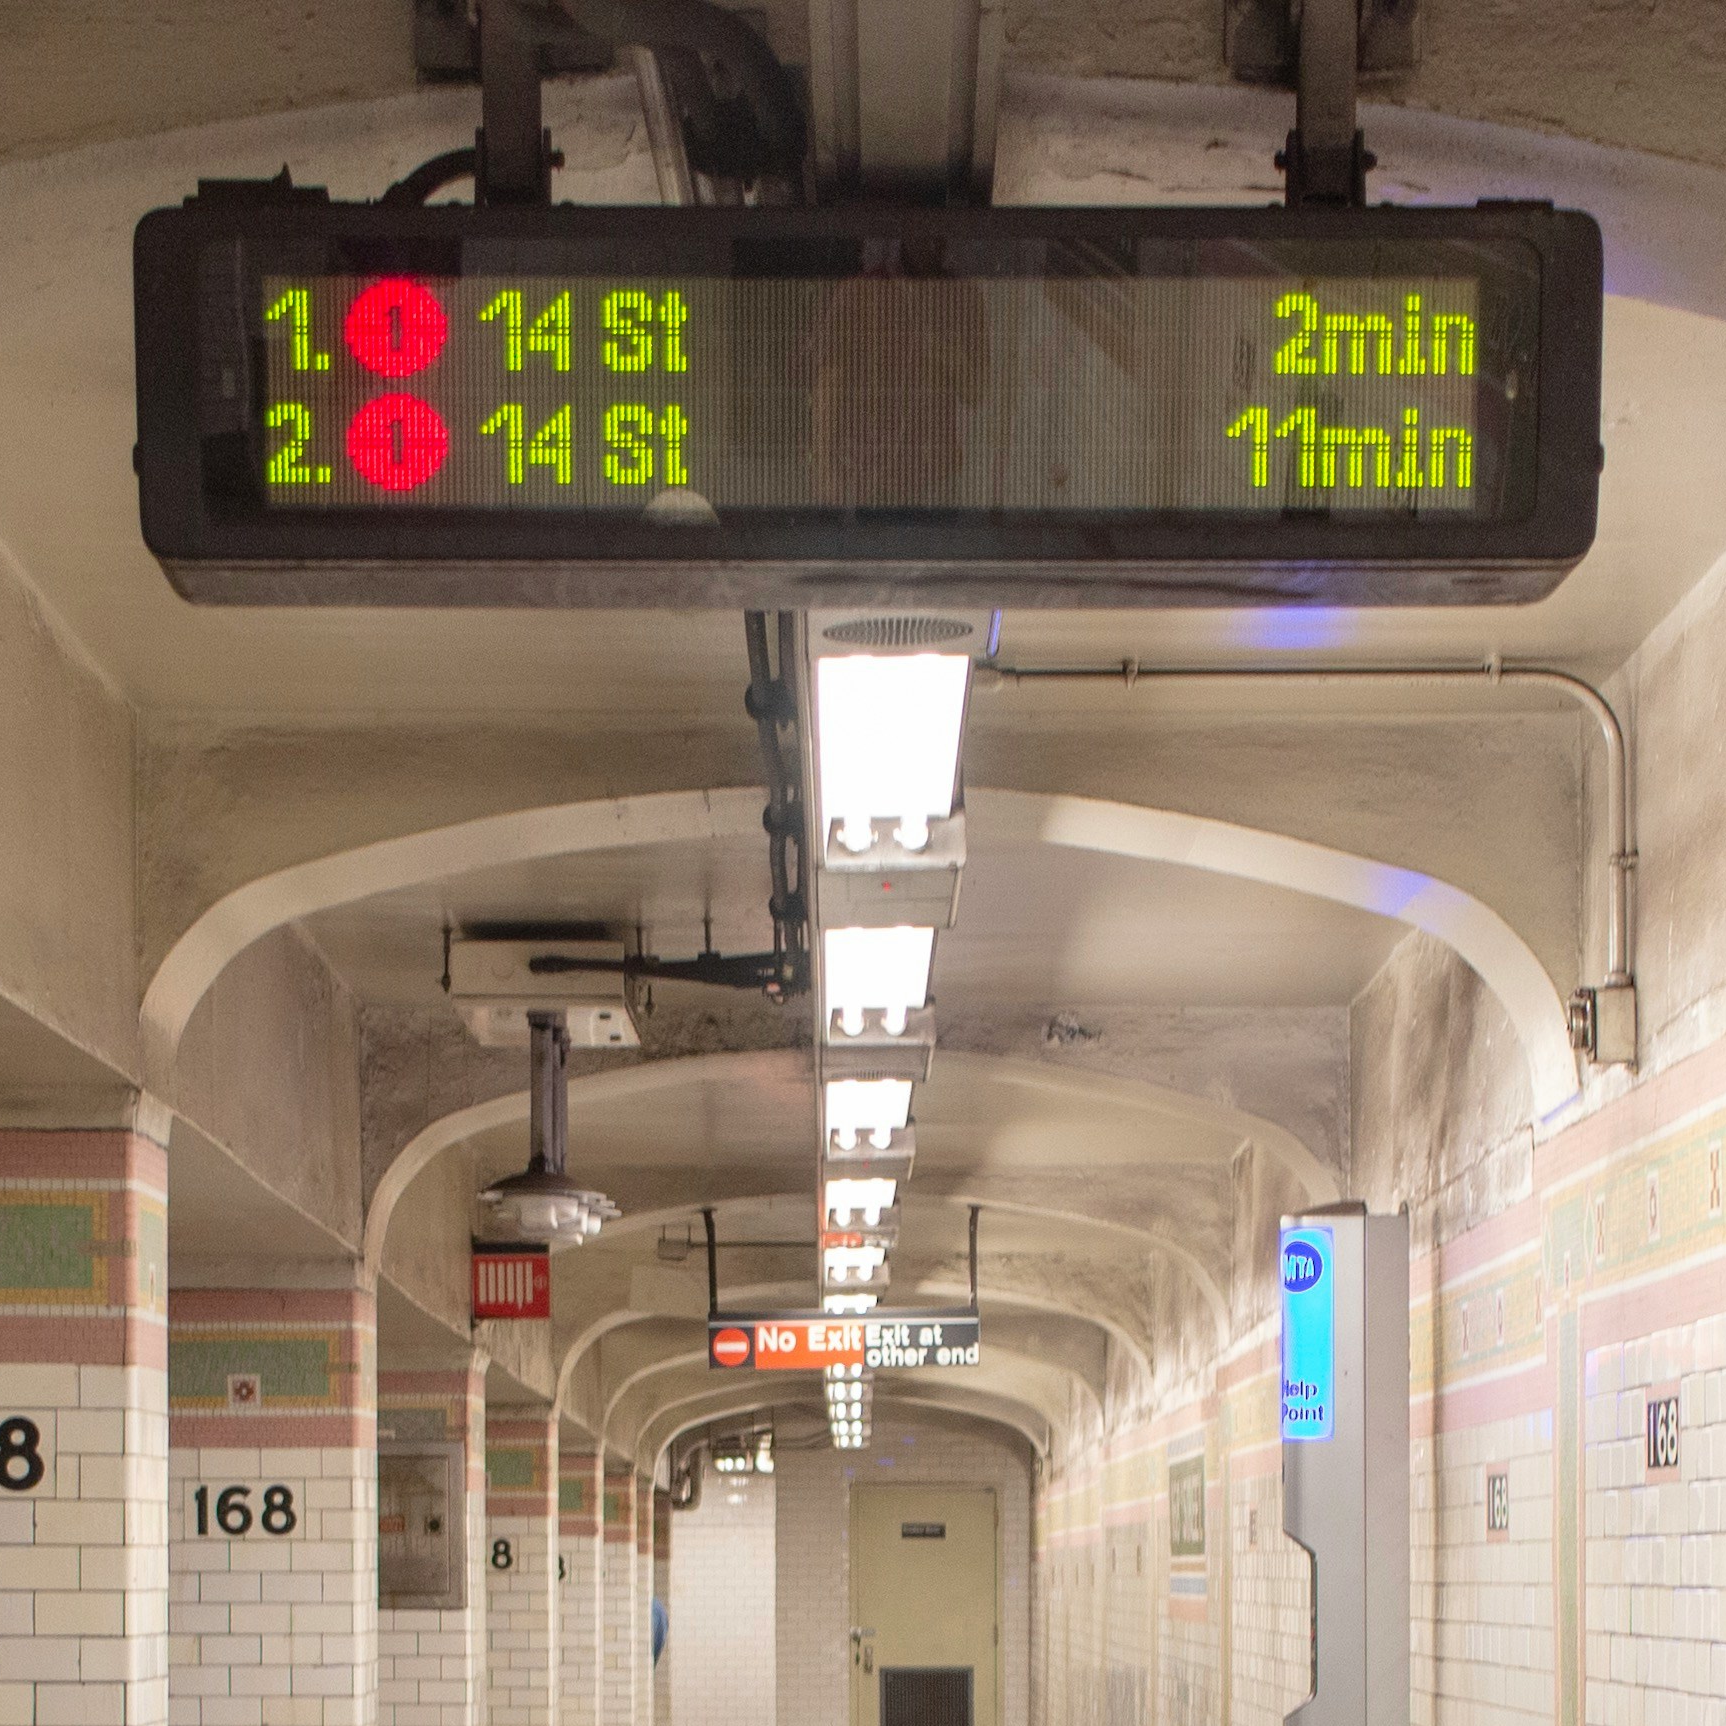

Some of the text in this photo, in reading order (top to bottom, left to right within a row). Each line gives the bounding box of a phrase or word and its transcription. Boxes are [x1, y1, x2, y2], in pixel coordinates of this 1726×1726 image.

[264, 288, 330, 371] 1.
[479, 289, 571, 372] 14
[602, 289, 689, 373] St
[1274, 292, 1474, 375] 2min
[264, 402, 332, 484] 2.
[479, 403, 572, 485] 14
[602, 403, 689, 486] St
[1224, 406, 1473, 488] 11min
[1282, 1253, 1316, 1281] MTA
[757, 1324, 863, 1353] No Exit
[865, 1323, 943, 1348] Exit at
[865, 1341, 980, 1368] other end
[1649, 1398, 1679, 1467] 168
[194, 1484, 297, 1536] 168
[1488, 1475, 1509, 1531] 168
